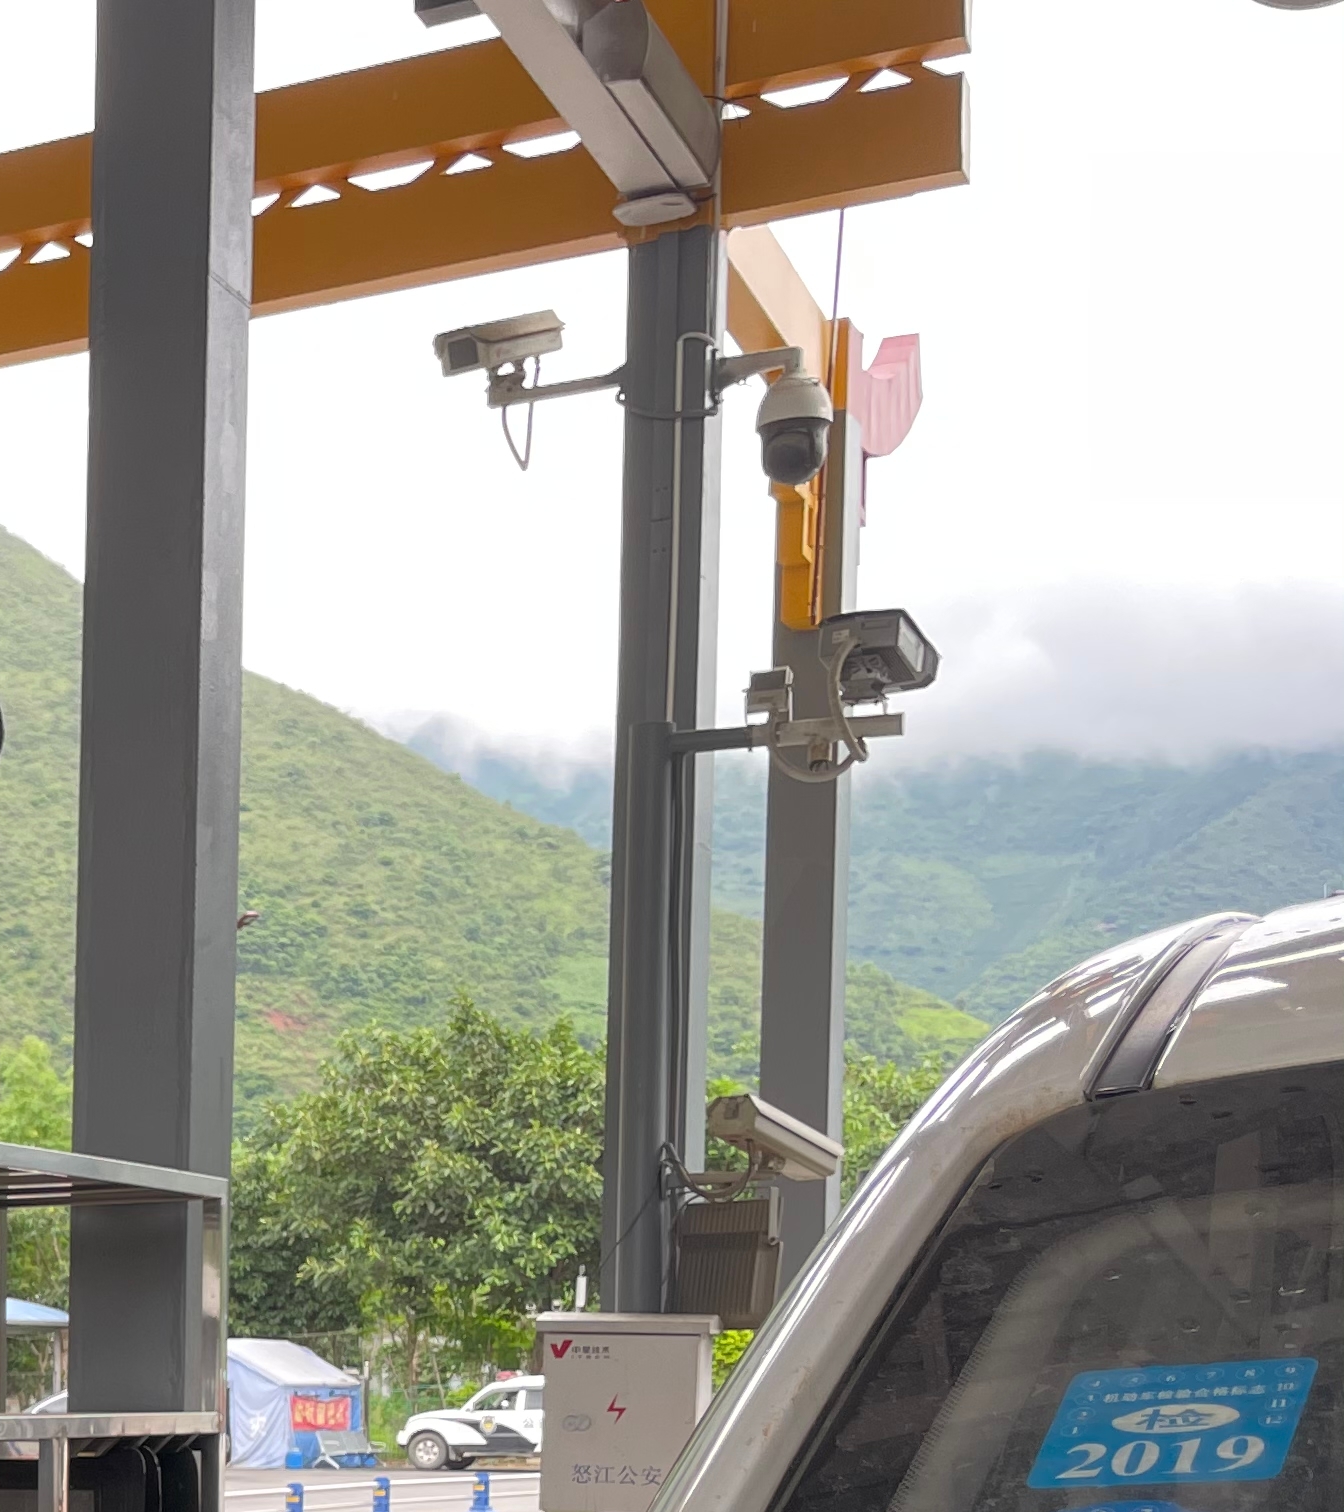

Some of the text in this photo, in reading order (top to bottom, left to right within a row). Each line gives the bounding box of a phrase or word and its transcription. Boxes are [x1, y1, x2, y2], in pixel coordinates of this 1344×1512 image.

[1055, 1435, 1265, 1480] 2019
[571, 1463, 663, 1487] 怒江公安
